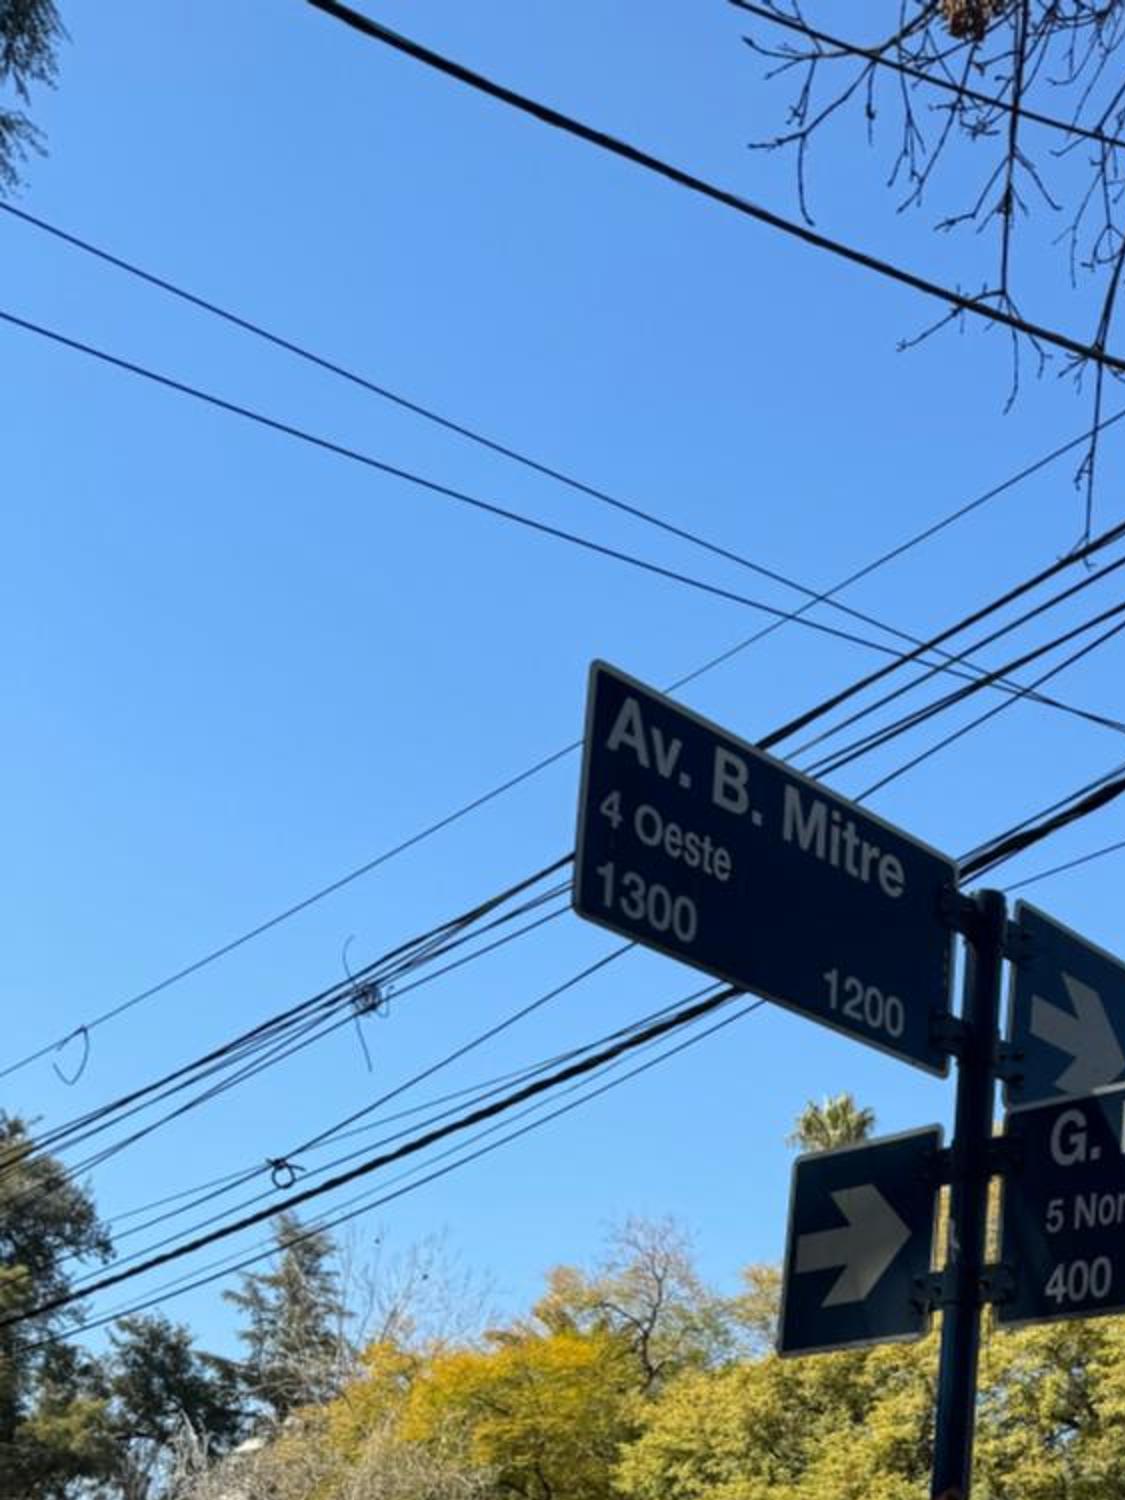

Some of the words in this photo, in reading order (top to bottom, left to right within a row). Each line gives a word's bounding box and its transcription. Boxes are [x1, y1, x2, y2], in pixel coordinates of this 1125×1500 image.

[607, 698, 691, 788] Av.
[712, 746, 763, 827] B.
[783, 784, 906, 898] Mitre
[600, 790, 623, 829] 4
[634, 804, 732, 881] Oeste
[597, 861, 698, 943] 1300
[823, 968, 906, 1038] 1200
[1050, 1108, 1101, 1166] G.
[1045, 1199, 1064, 1233] 5
[1045, 1256, 1113, 1304] 400
